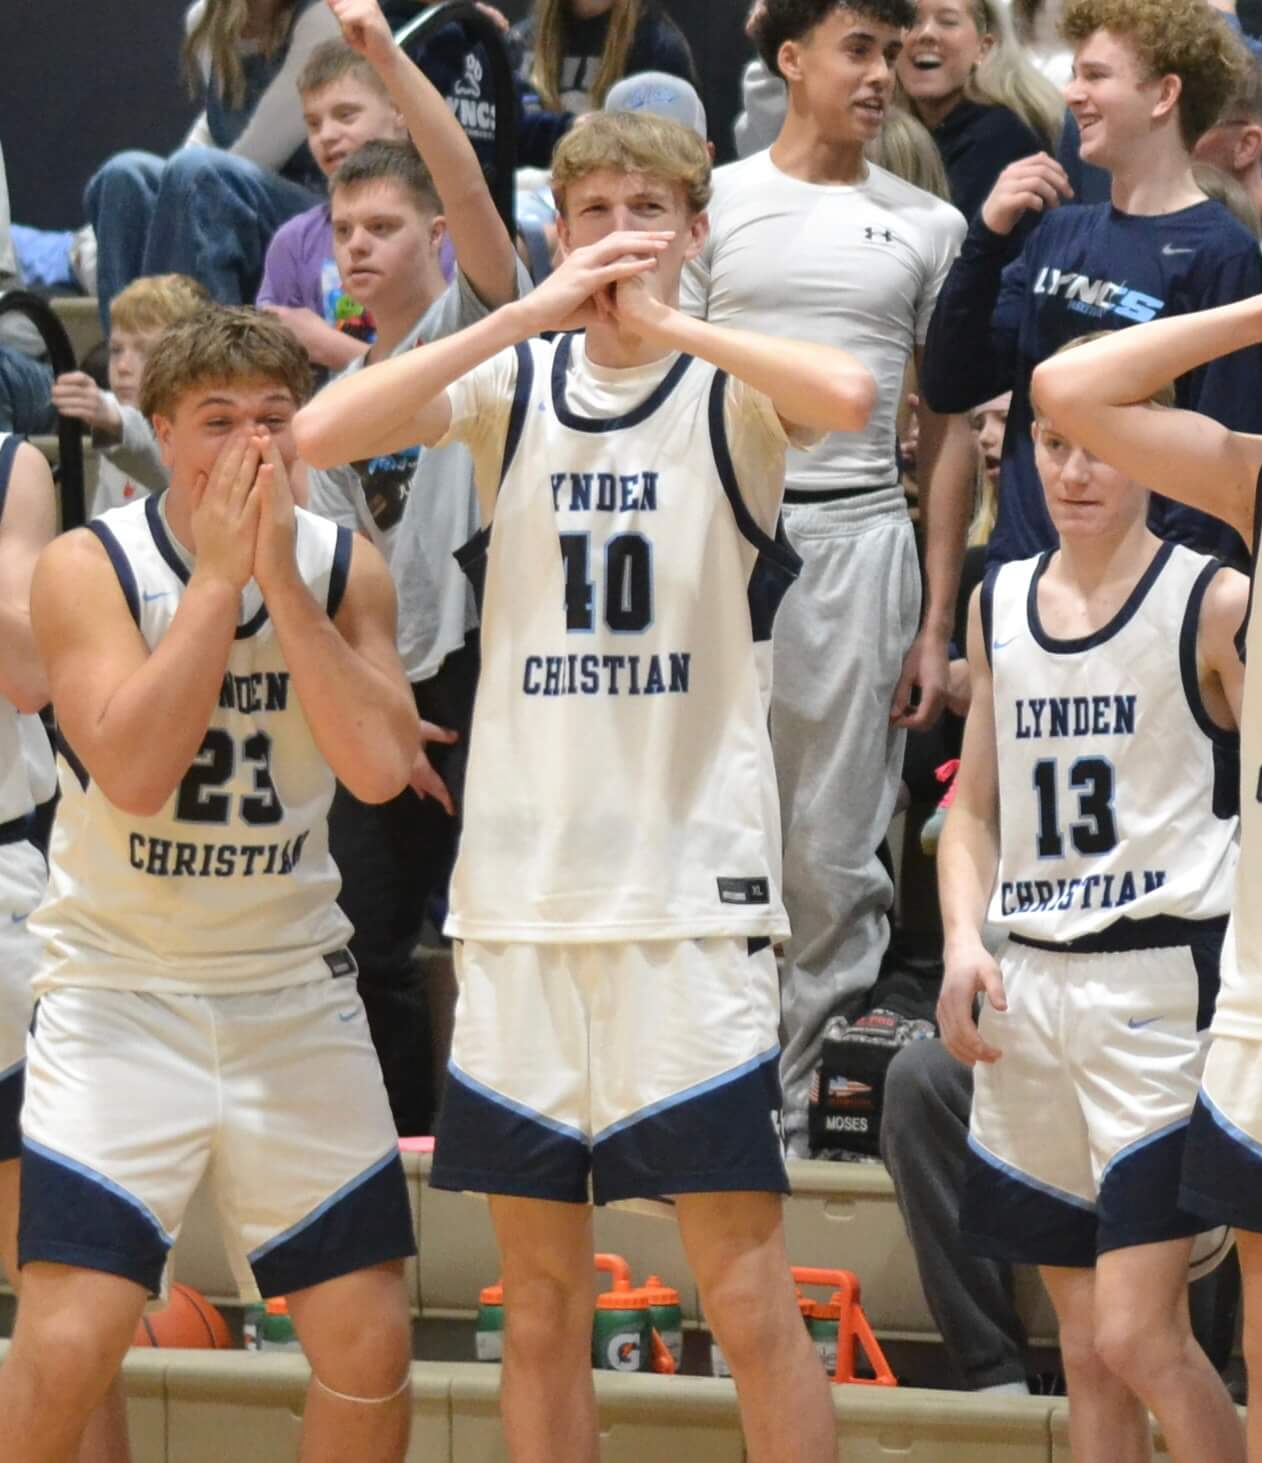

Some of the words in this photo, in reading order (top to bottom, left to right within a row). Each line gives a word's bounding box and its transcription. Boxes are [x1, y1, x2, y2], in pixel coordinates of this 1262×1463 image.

[550, 472, 659, 512] YNDEN
[218, 671, 290, 714] NDEN
[522, 653, 691, 695] CHISTIAN
[1015, 695, 1137, 739] LYNDEN
[174, 727, 284, 828] 23
[1032, 754, 1120, 860] 13
[1001, 869, 1167, 917] CHRISTIAN
[825, 1115, 869, 1132] MOSES
[607, 1333, 641, 1371] G
